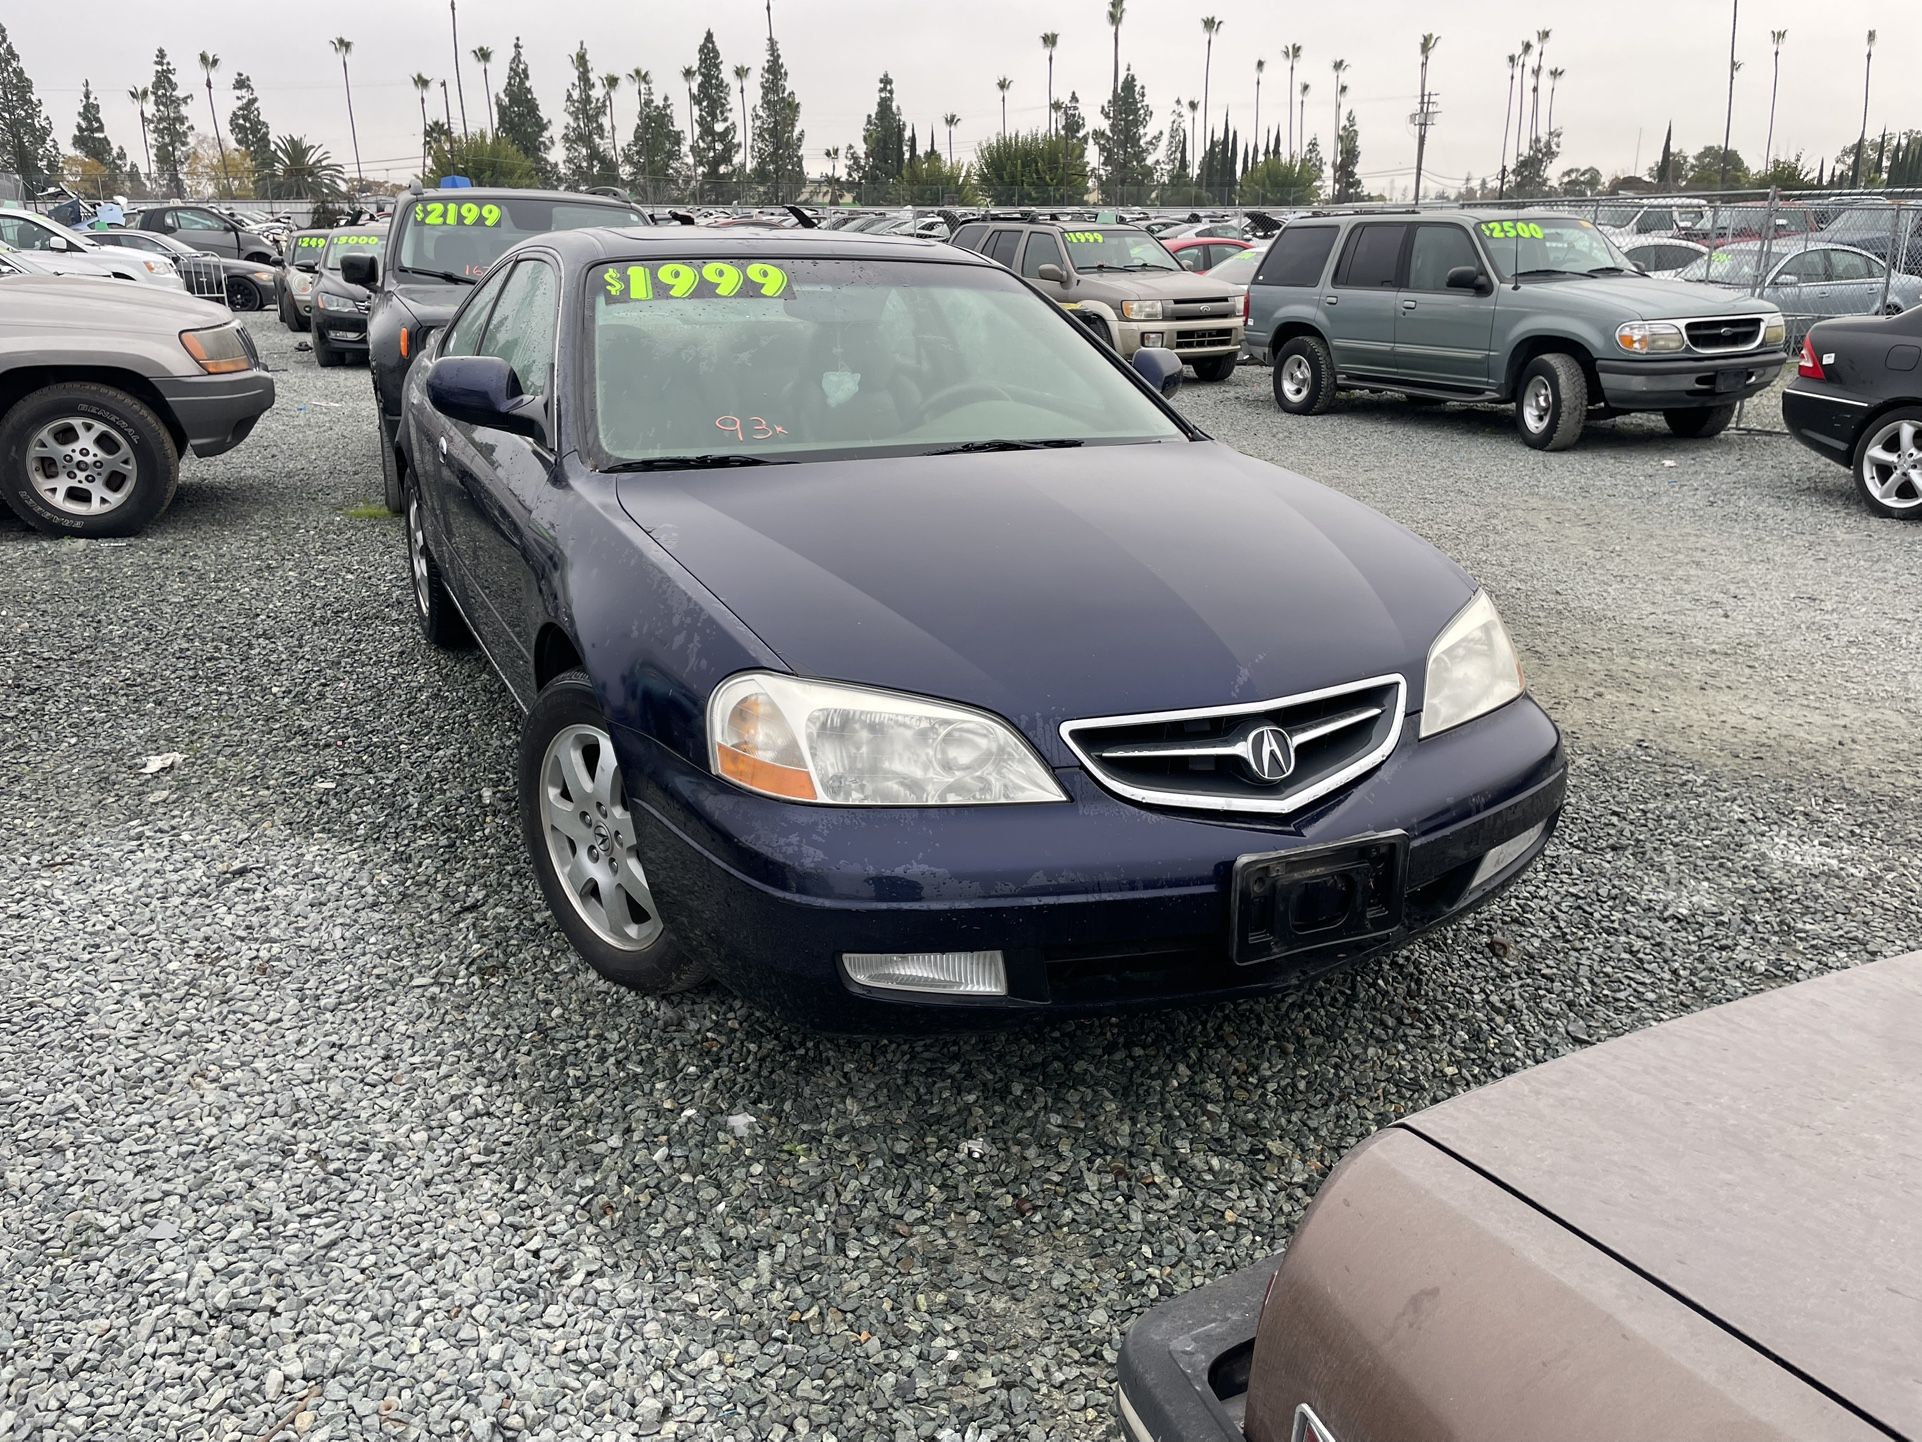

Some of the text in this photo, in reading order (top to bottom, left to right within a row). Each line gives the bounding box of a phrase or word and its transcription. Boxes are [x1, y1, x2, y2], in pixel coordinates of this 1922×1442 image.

[415, 203, 502, 227] $2199
[1480, 221, 1544, 239] $2500
[603, 262, 788, 300] $1999
